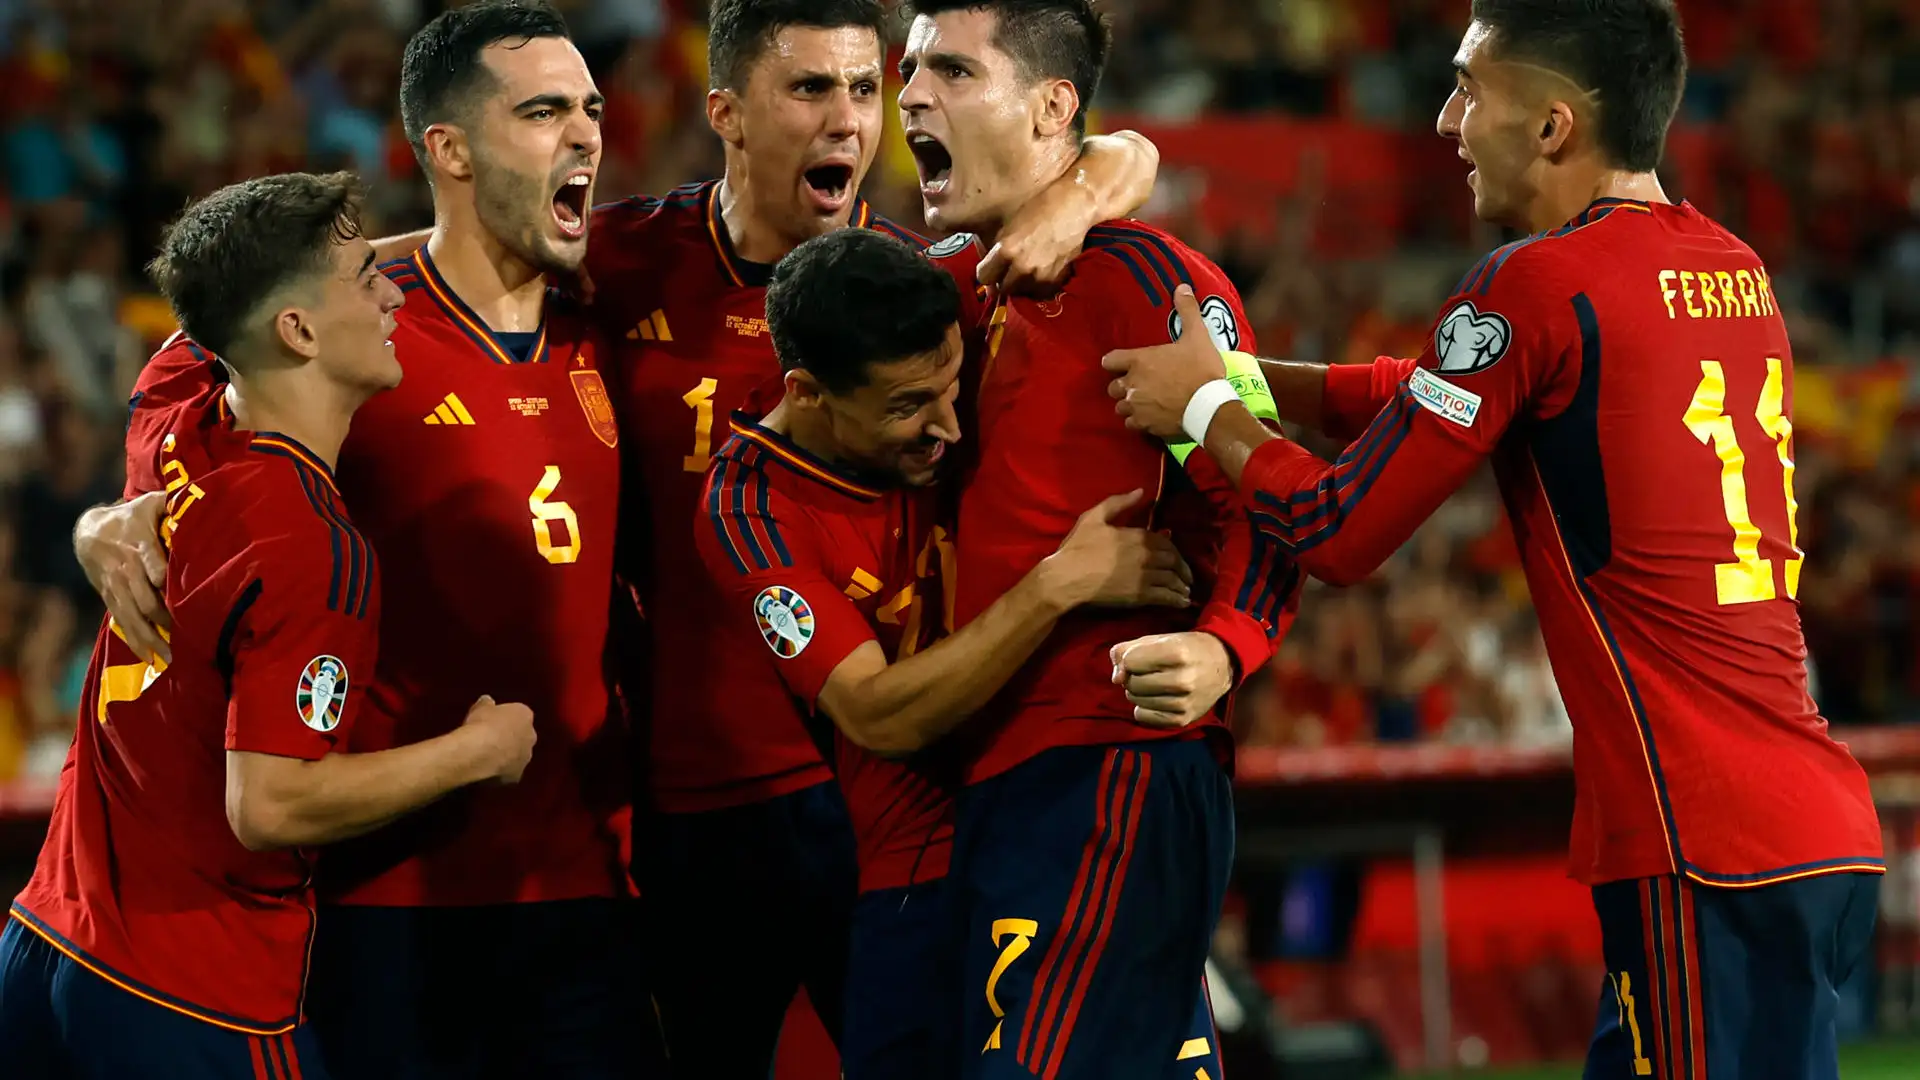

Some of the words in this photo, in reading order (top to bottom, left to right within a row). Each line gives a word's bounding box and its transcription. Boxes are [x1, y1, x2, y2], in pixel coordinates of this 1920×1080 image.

[1658, 266, 1775, 319] FERRAN
[1409, 377, 1476, 417] FOUNDATION
[529, 465, 581, 564] 6
[1682, 357, 1806, 605] 11
[981, 917, 1039, 1056] 7
